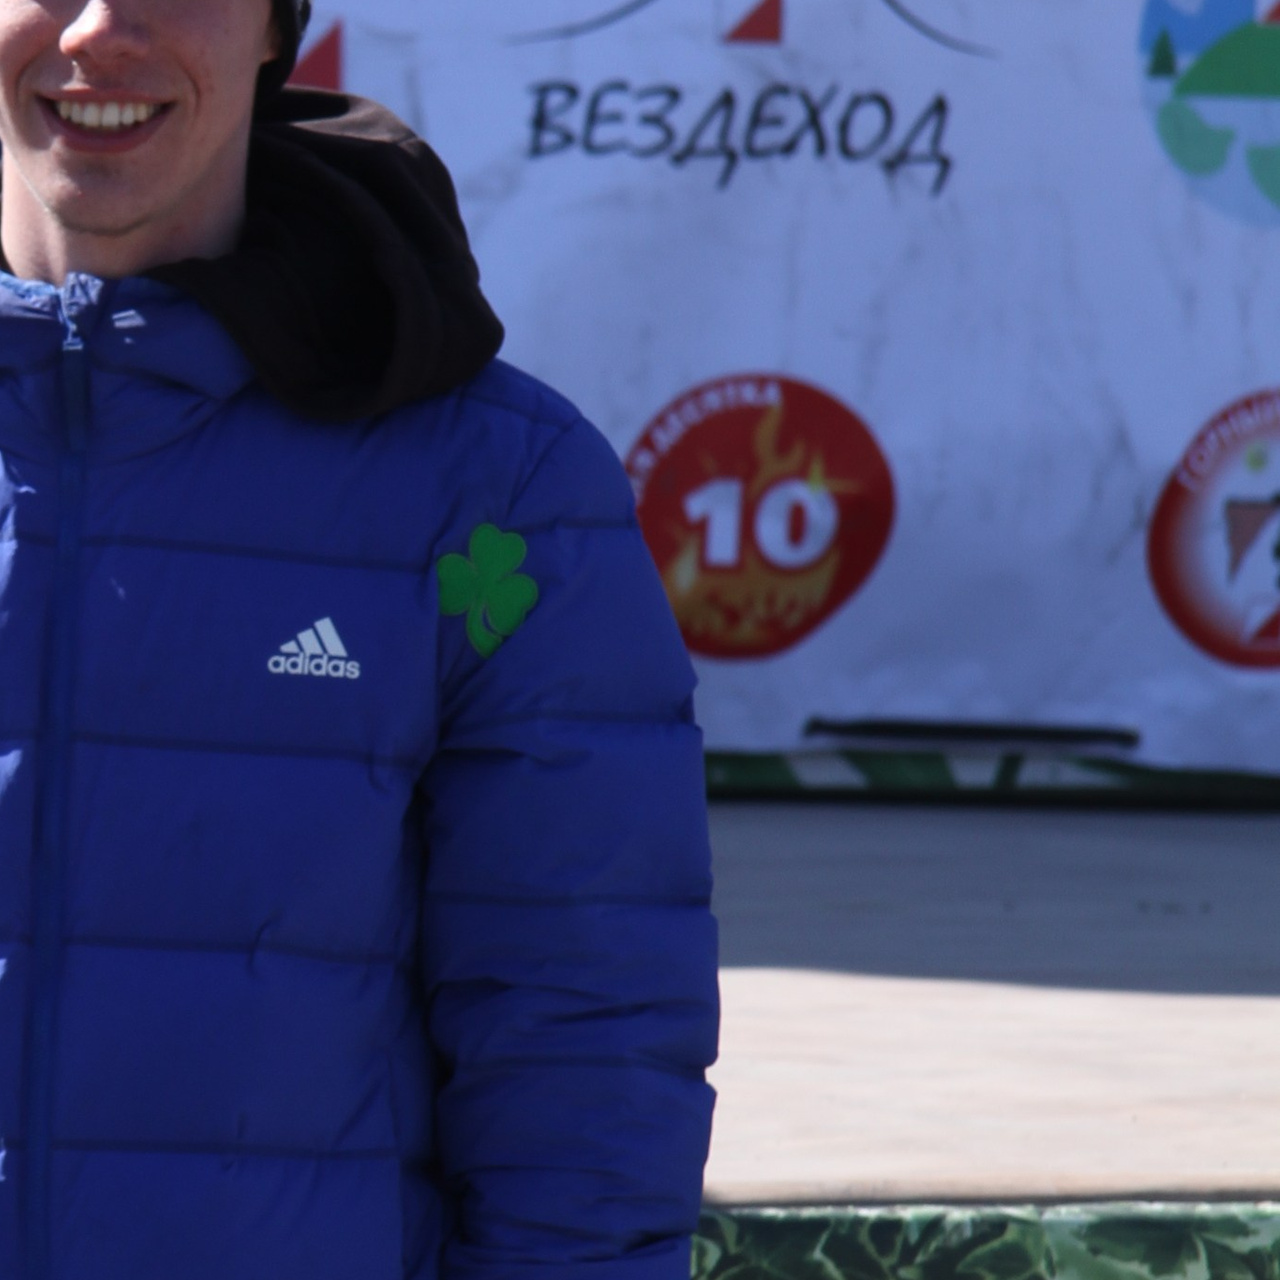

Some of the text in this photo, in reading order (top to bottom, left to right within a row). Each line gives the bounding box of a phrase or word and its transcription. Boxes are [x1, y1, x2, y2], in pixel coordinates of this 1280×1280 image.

[526, 80, 953, 198] ВЕЗДЕХОД
[682, 477, 841, 570] 10
[267, 651, 361, 679] adidas
